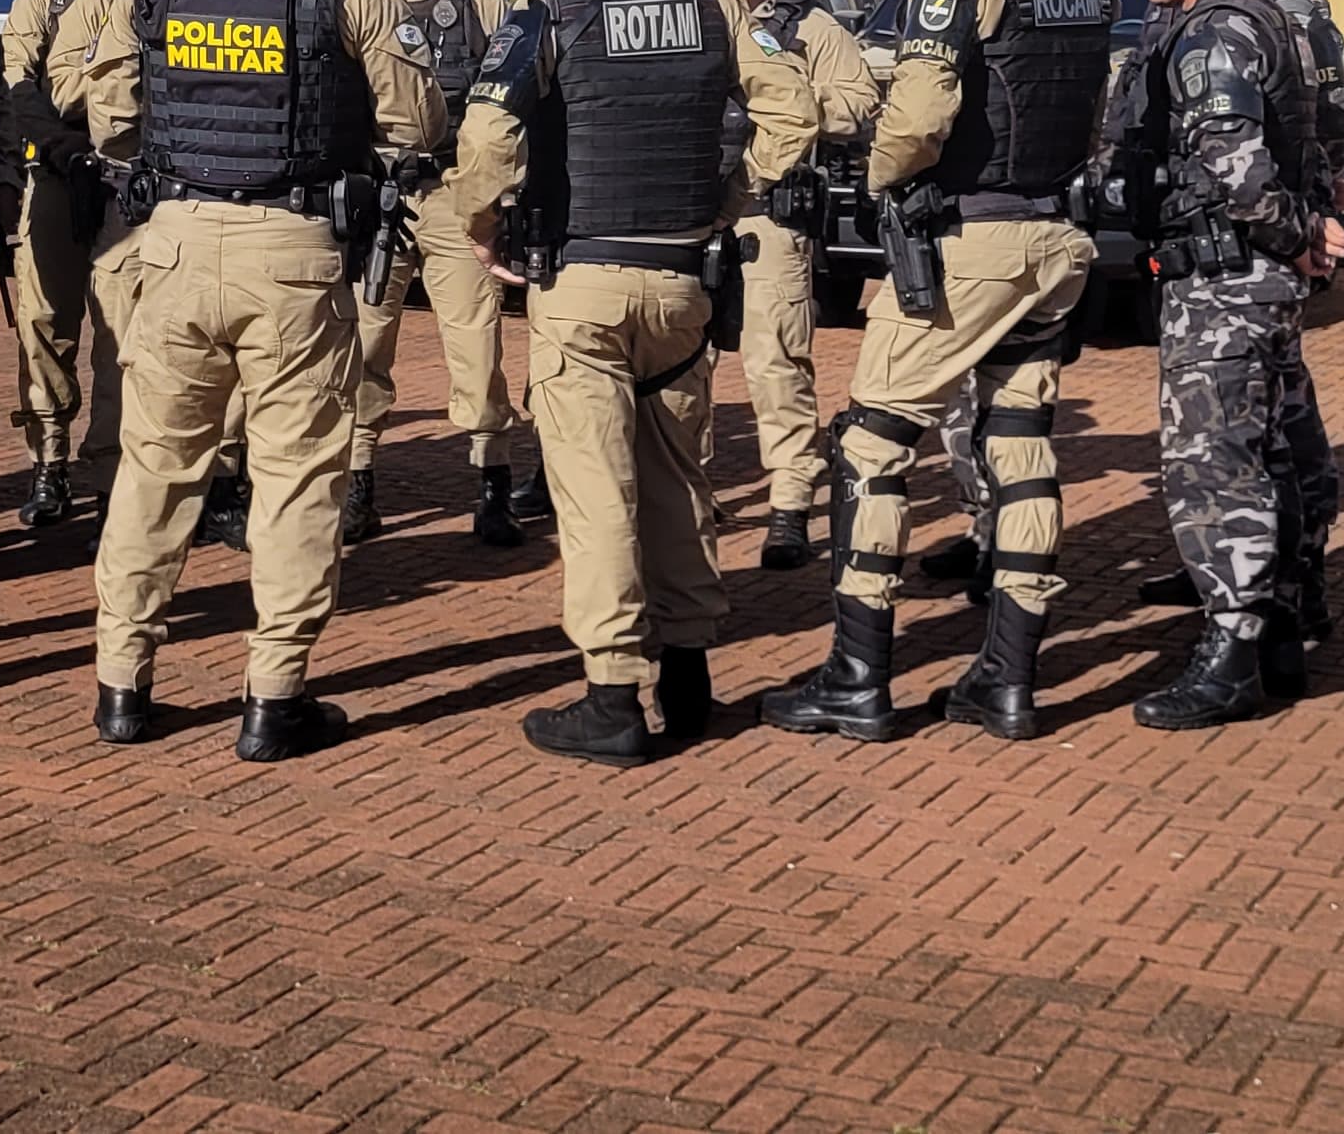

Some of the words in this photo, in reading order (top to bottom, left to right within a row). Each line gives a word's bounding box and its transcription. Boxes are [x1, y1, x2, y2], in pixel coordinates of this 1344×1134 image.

[166, 18, 286, 49] POLÍCIA
[608, 3, 697, 51] ROTAM
[167, 44, 285, 73] MILITAR
